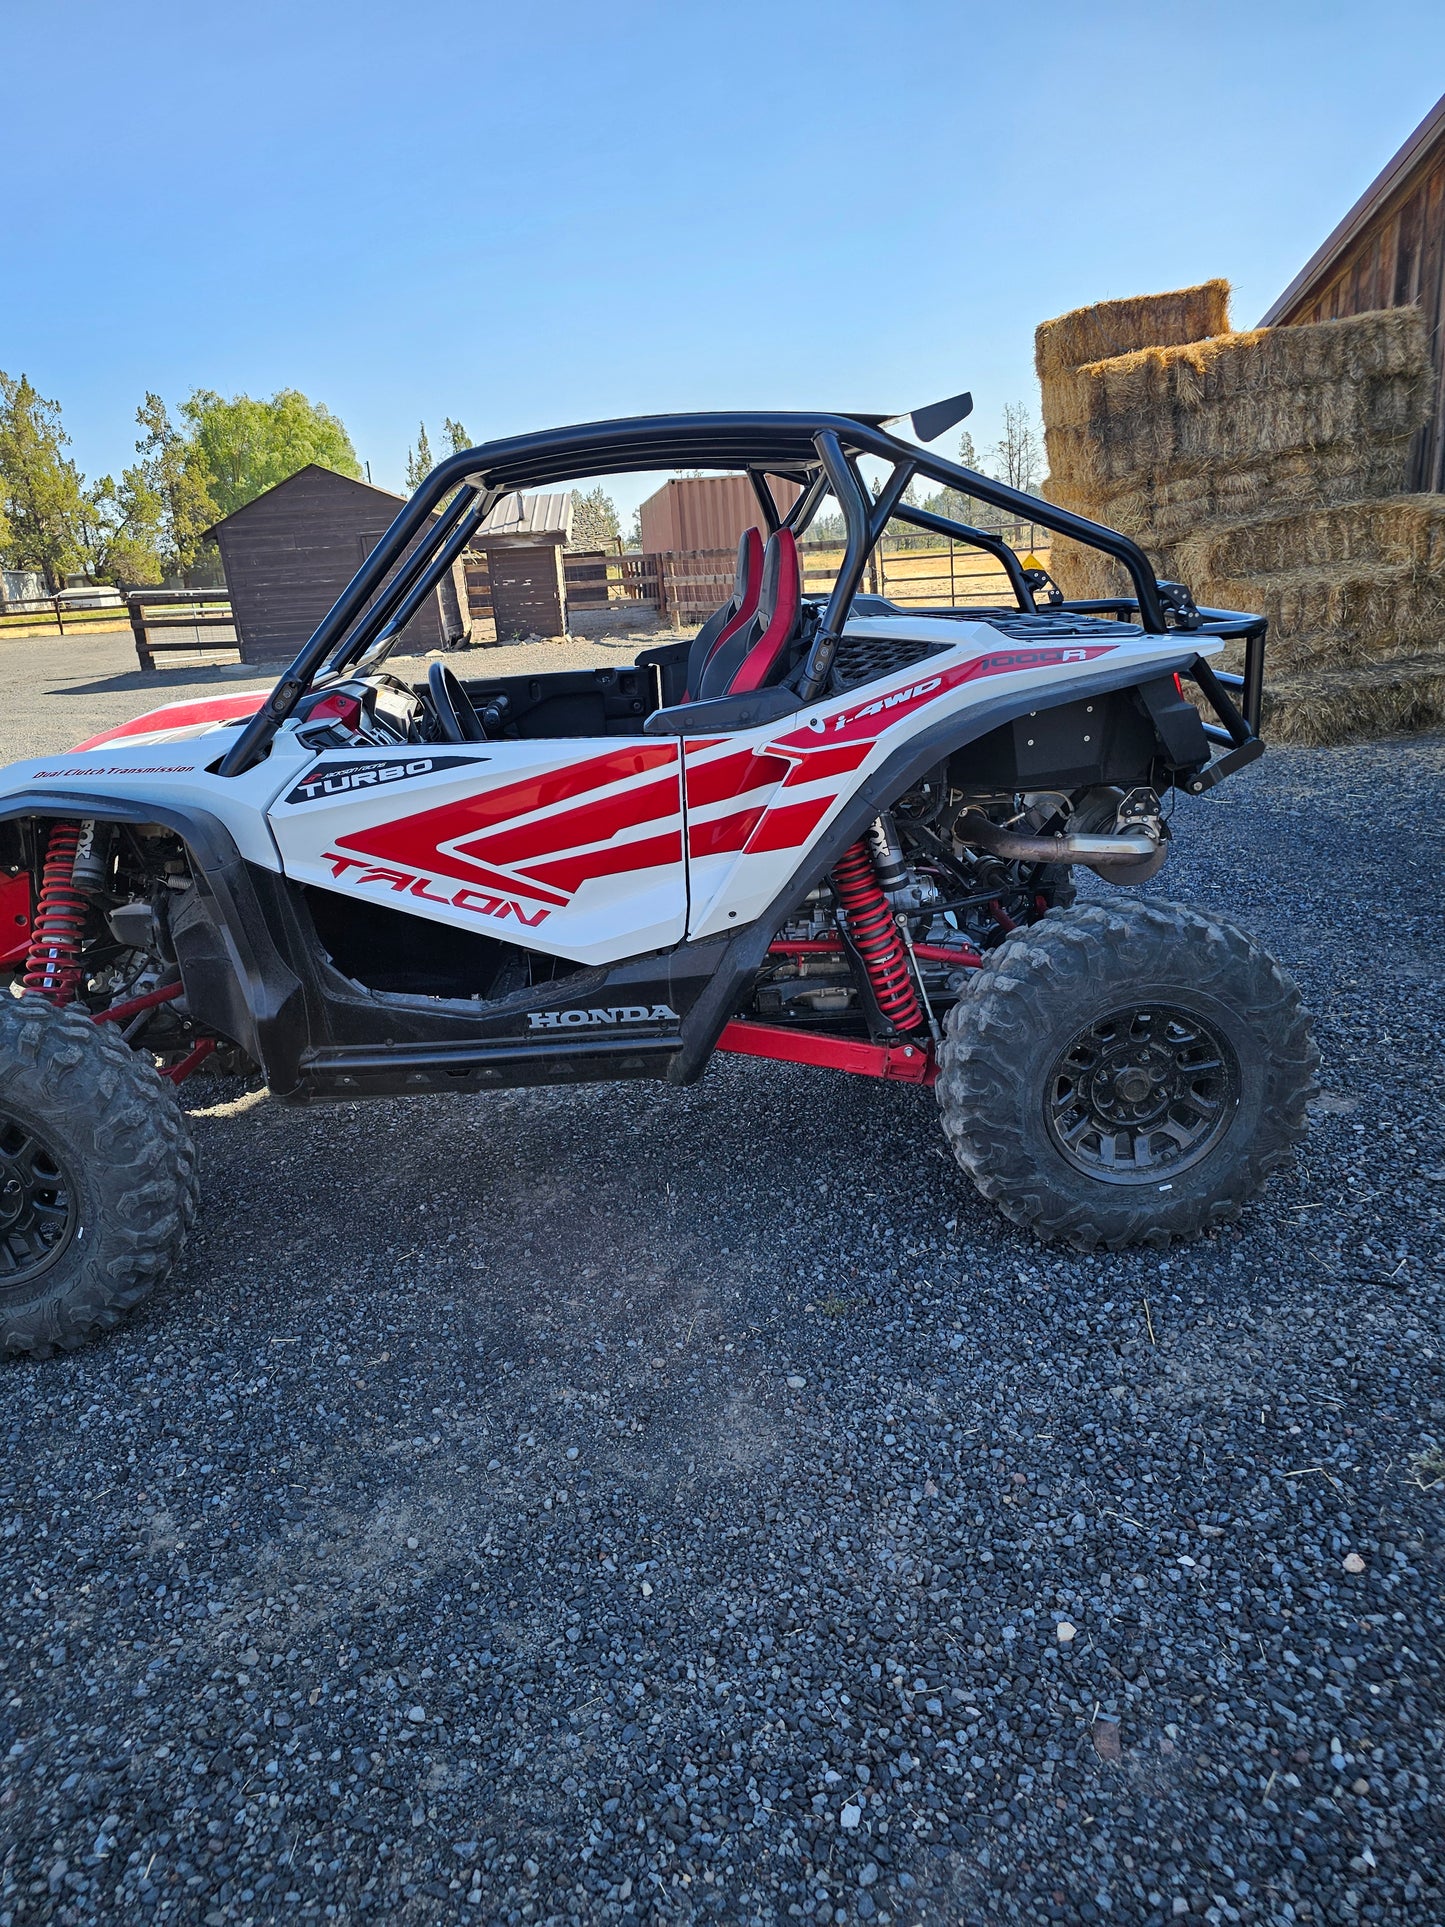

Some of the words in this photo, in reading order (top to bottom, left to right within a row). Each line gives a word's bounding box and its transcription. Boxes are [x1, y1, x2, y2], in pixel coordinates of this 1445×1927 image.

[982, 649, 1087, 671] 1000R
[834, 677, 942, 732] i-4WD
[32, 769, 65, 779] Dual
[63, 768, 106, 777] Clutch
[107, 765, 195, 775] Transmission
[296, 758, 434, 798] TURBO
[75, 819, 95, 860] FOX
[320, 851, 552, 928] TALON
[527, 1004, 681, 1029] HONDA
